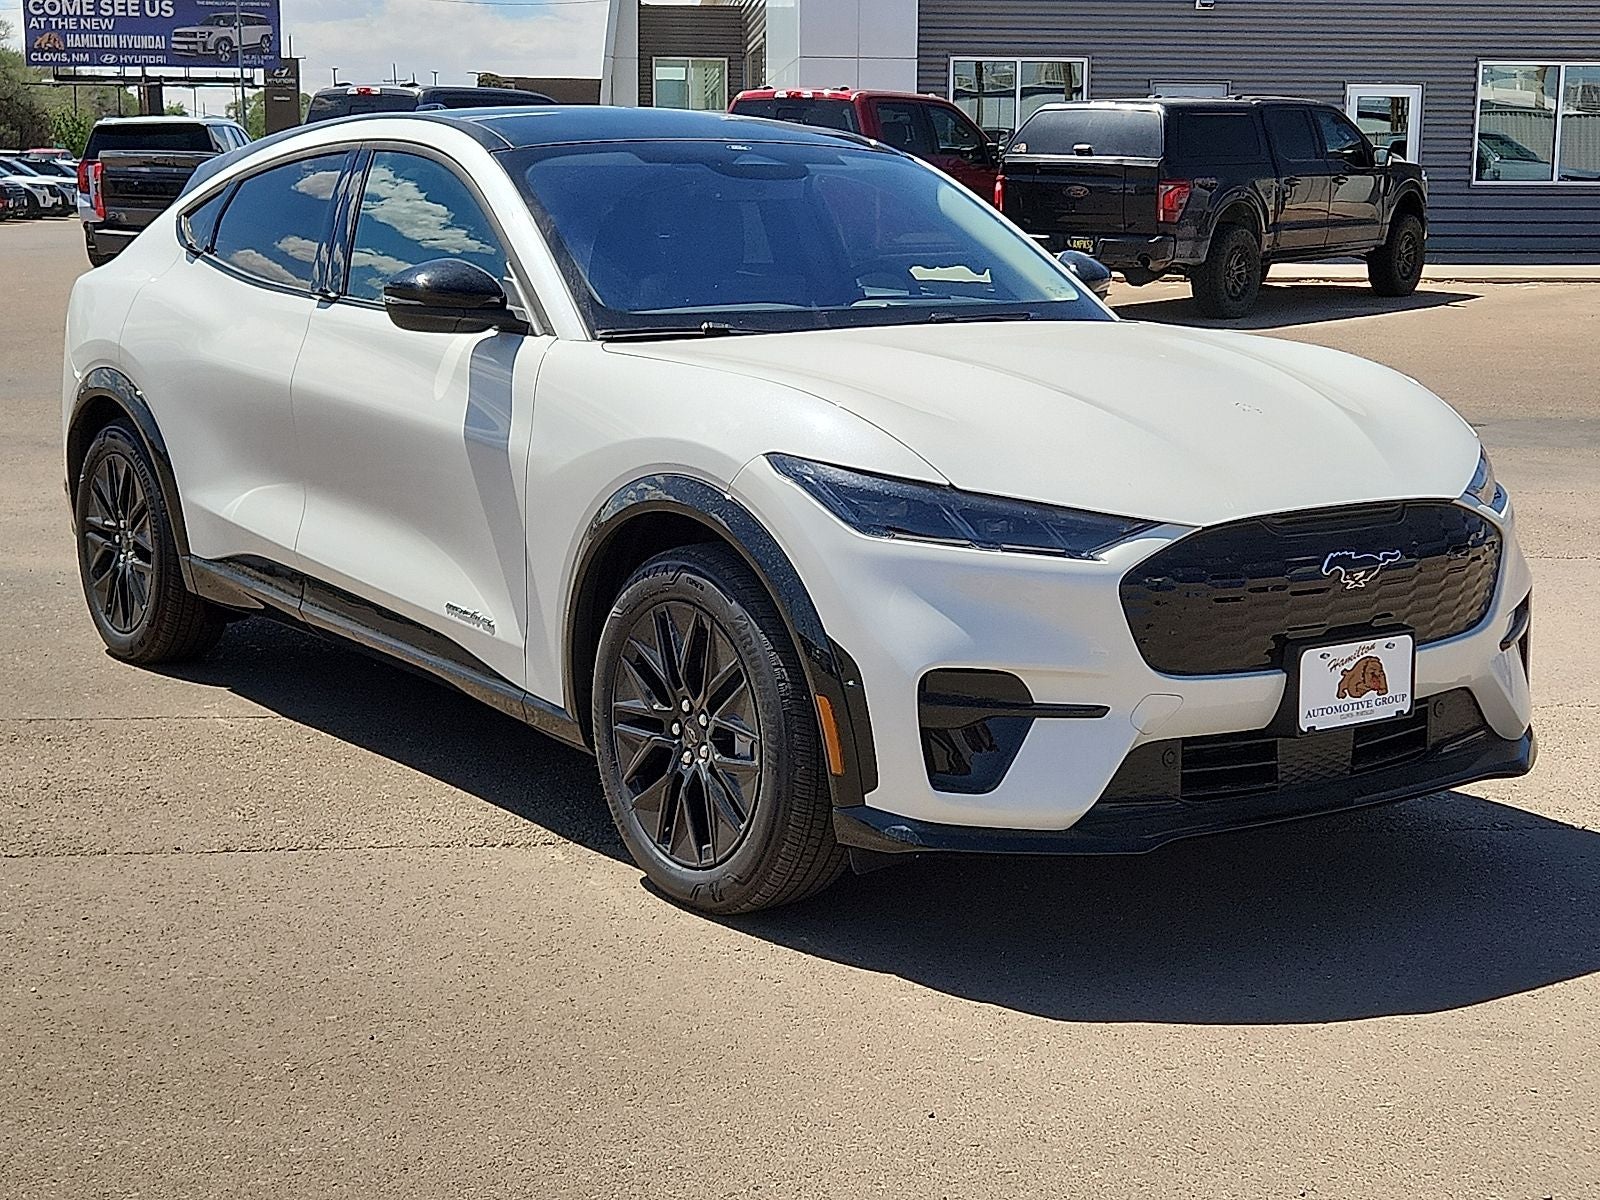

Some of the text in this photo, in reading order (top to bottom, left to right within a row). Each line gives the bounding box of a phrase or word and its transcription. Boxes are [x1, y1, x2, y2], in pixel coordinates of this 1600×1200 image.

[28, 0, 174, 17] COME SEE US
[29, 18, 115, 30] AT THE NEW
[66, 33, 166, 49] HAMILTON HYUNDAI
[30, 52, 167, 64] CLOVIS, NM HYUNDAI
[1327, 643, 1376, 672] Hamilton
[1305, 699, 1373, 719] AUTOMOTIVE
[1374, 693, 1408, 708] GROUP
